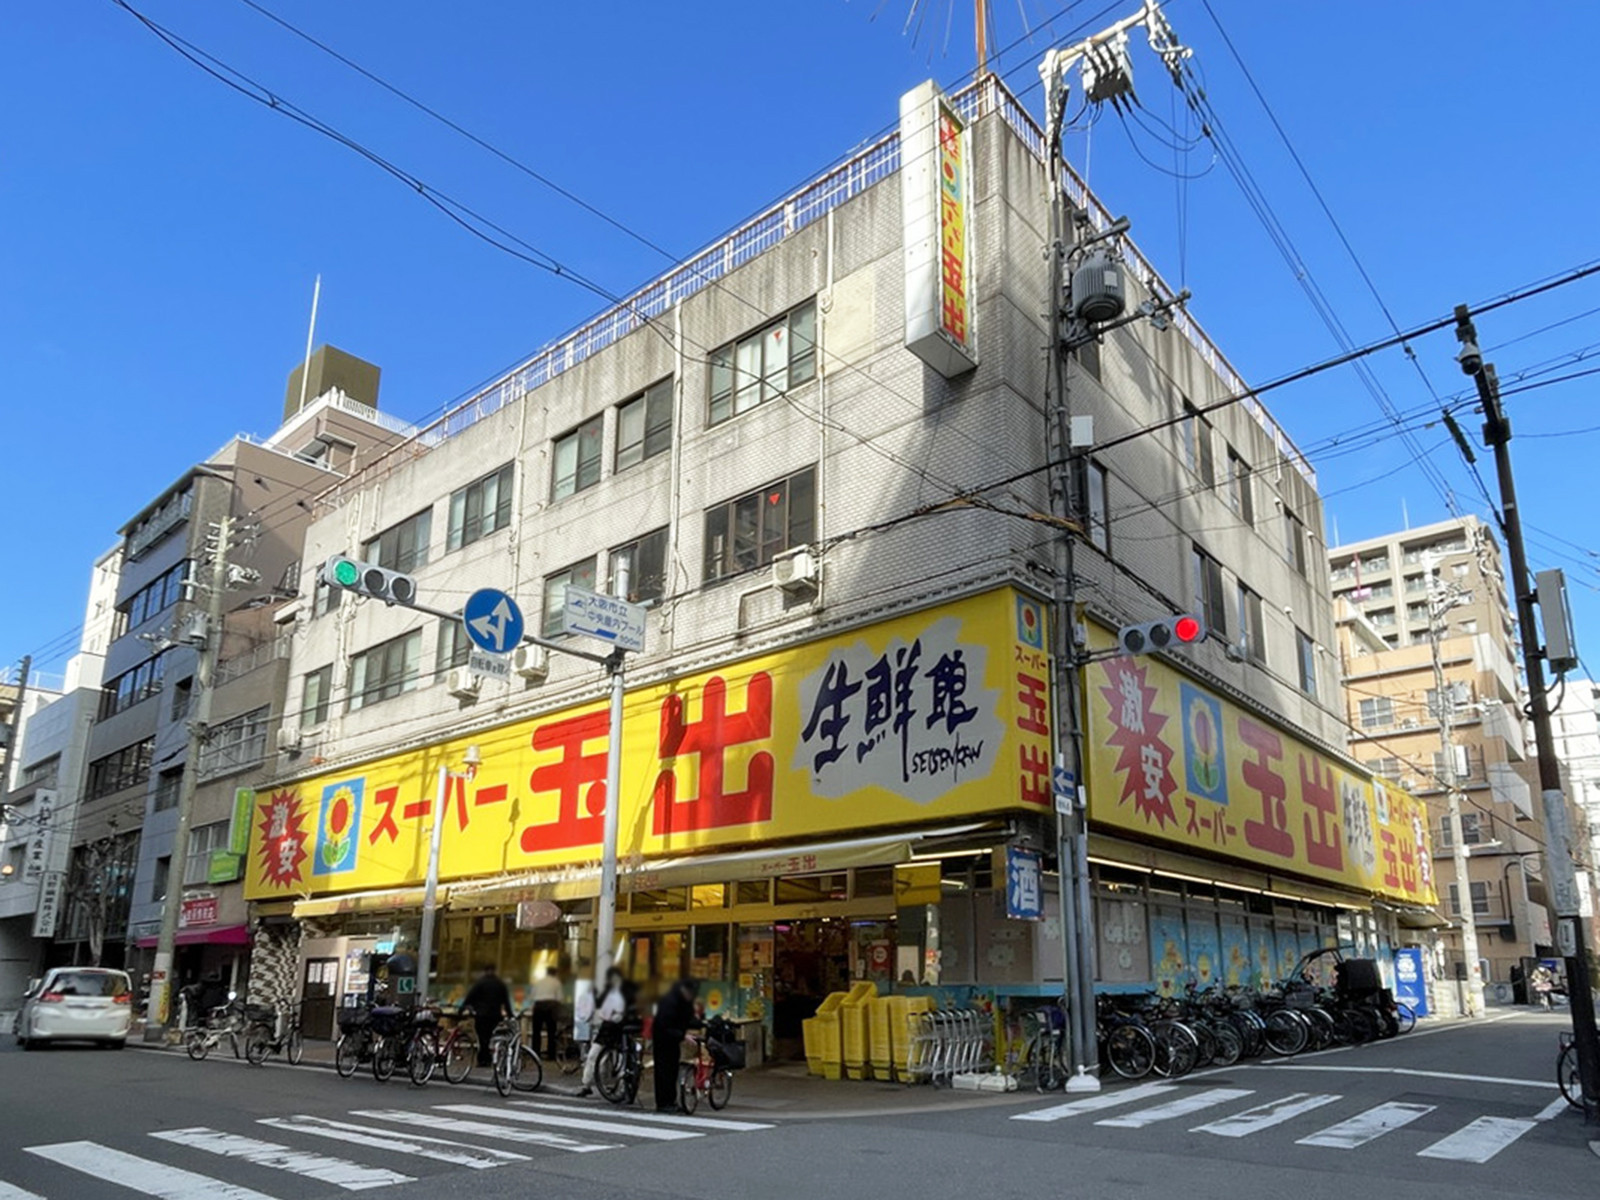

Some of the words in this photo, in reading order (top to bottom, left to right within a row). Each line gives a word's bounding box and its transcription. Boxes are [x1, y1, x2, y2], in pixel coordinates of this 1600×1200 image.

[588, 596, 628, 617] 大阪市立
[1015, 645, 1047, 671] スーパー
[801, 638, 978, 783] 生鮮館
[1017, 672, 1051, 806] 玉出
[1119, 669, 1164, 804] 激安
[1184, 797, 1237, 846] スーパー
[1238, 716, 1344, 872] 玉出
[269, 801, 297, 874] 激安
[1011, 855, 1040, 911] 酒
